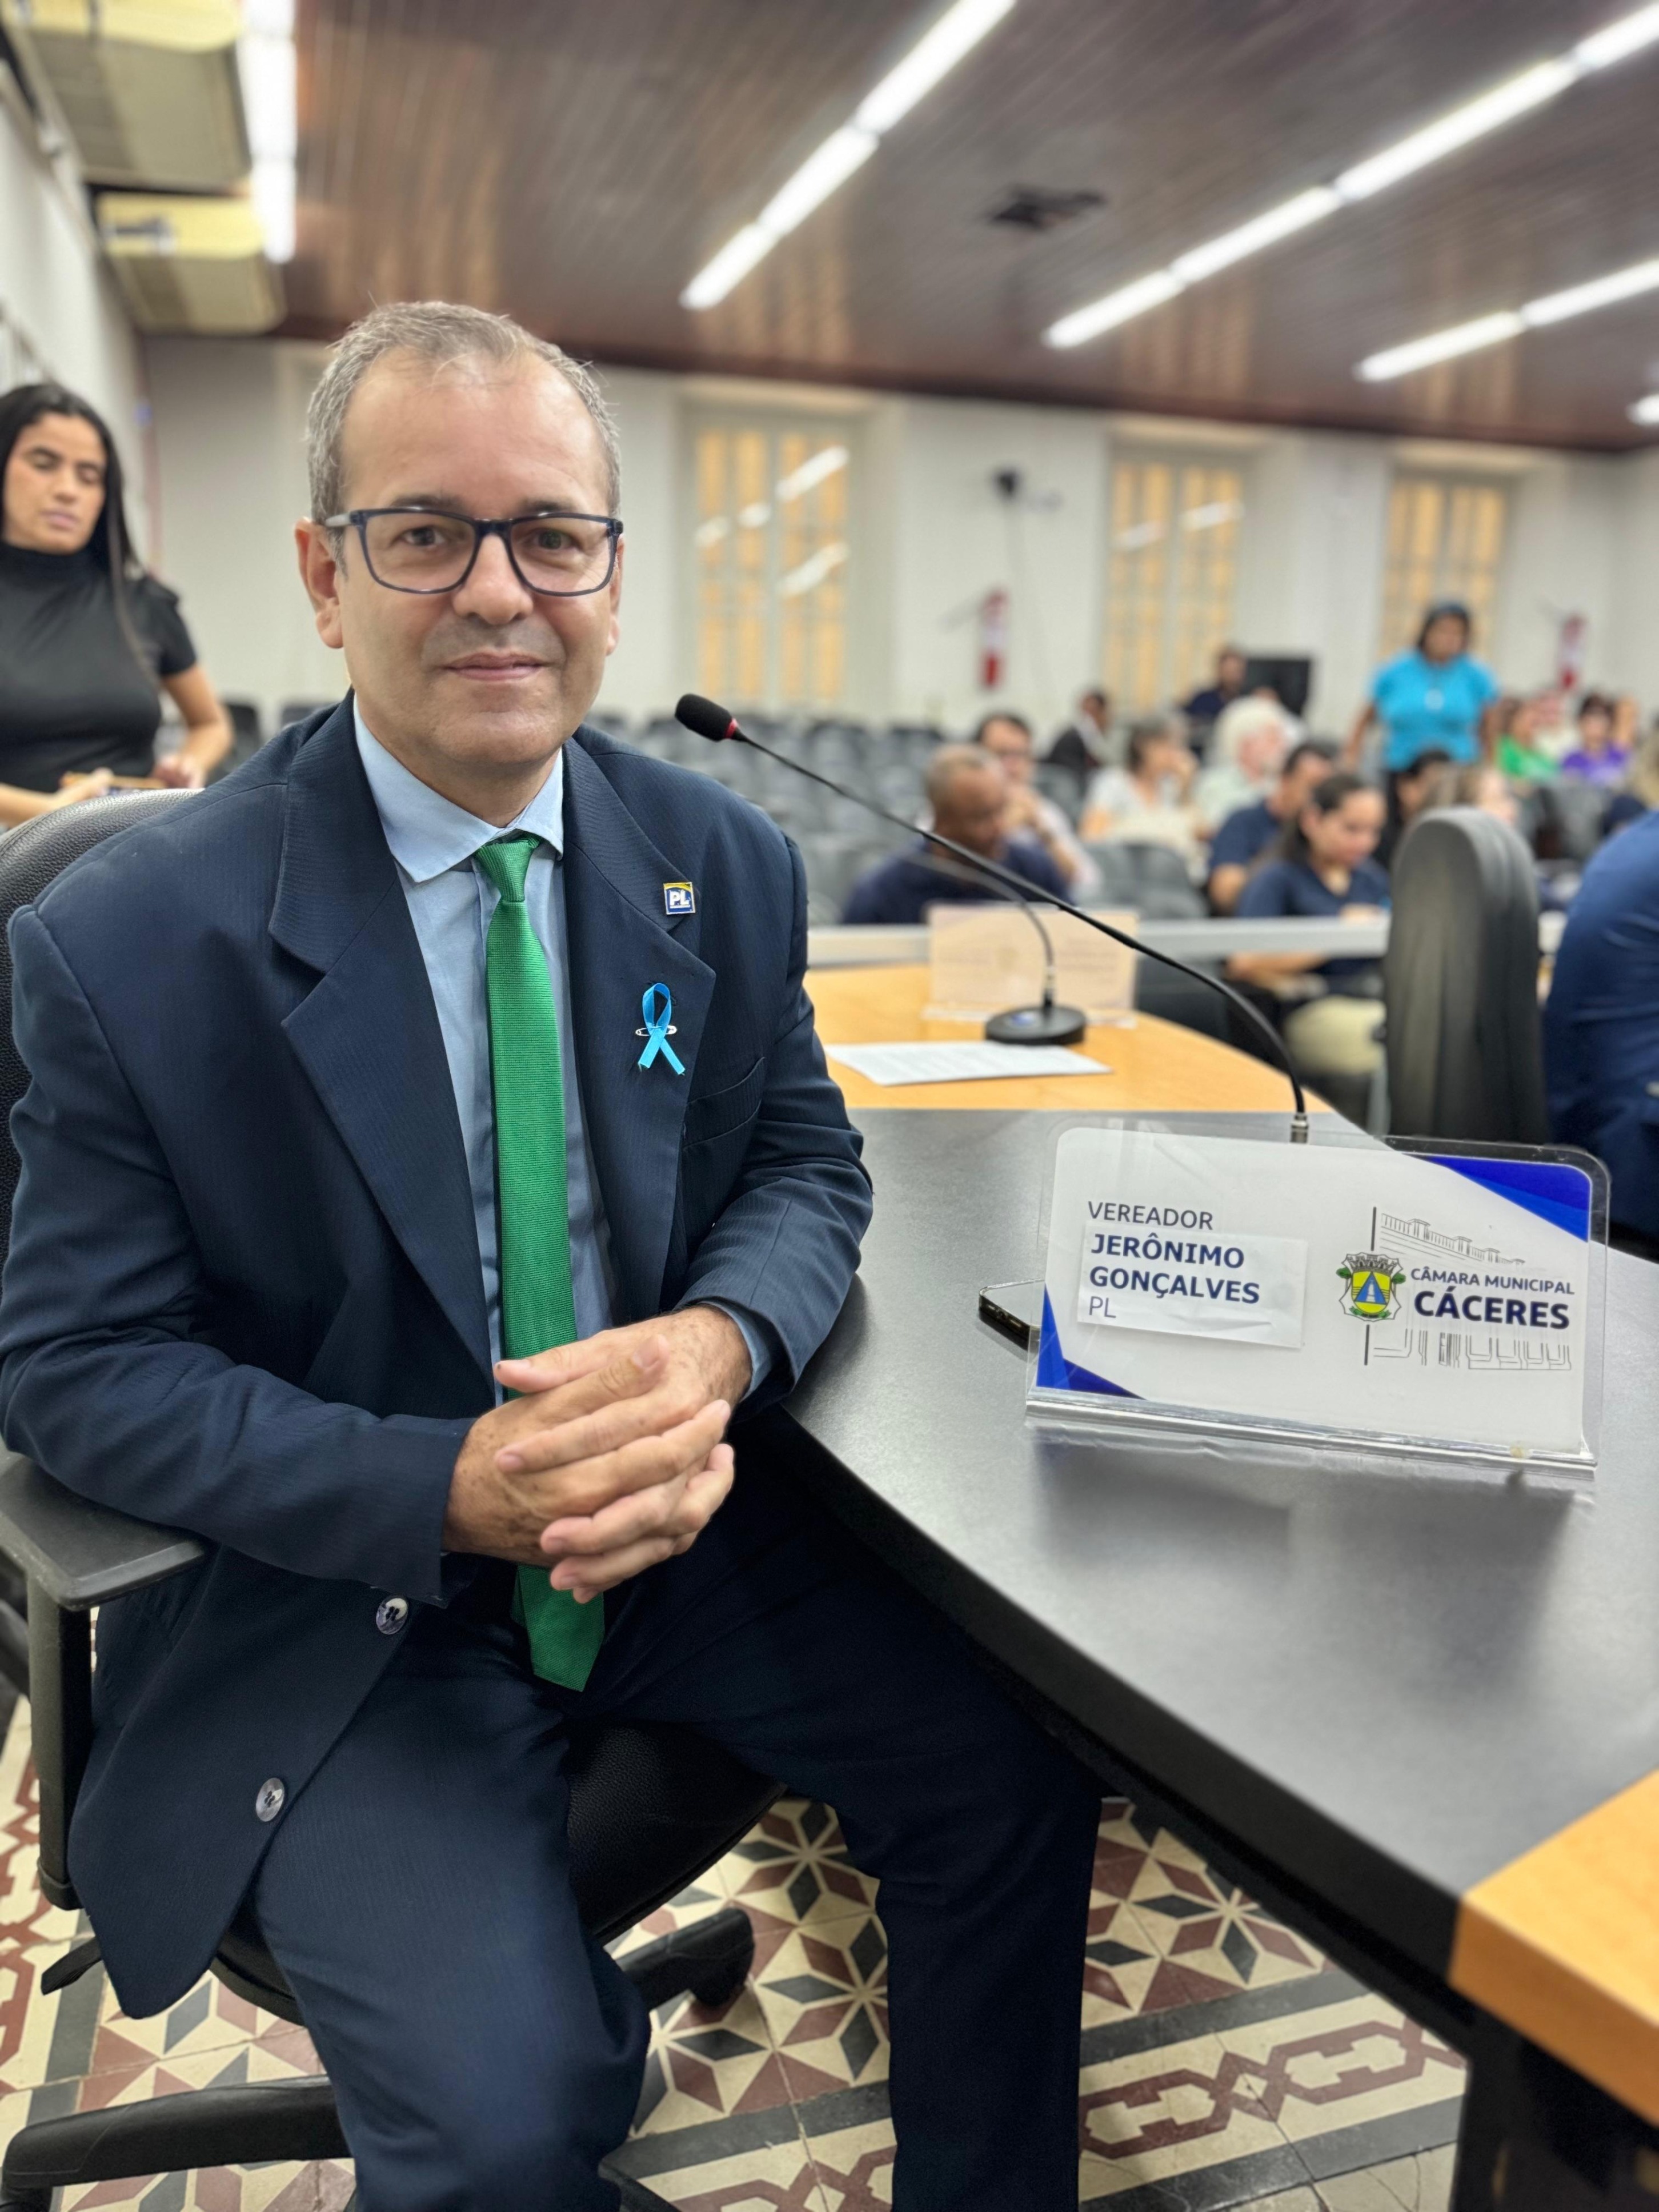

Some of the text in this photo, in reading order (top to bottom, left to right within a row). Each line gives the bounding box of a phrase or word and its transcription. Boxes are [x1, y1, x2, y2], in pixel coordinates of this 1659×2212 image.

[669, 889, 690, 905] PL
[1088, 1201, 1213, 1231] VEREADOR
[1091, 1232, 1244, 1269] JERÔNIMO
[1089, 1266, 1260, 1304] GONÇALVES
[1410, 1266, 1575, 1295] CÂMARA MUNICIPAL
[1089, 1296, 1117, 1319] PL
[1414, 1285, 1570, 1330] CÁCERES
